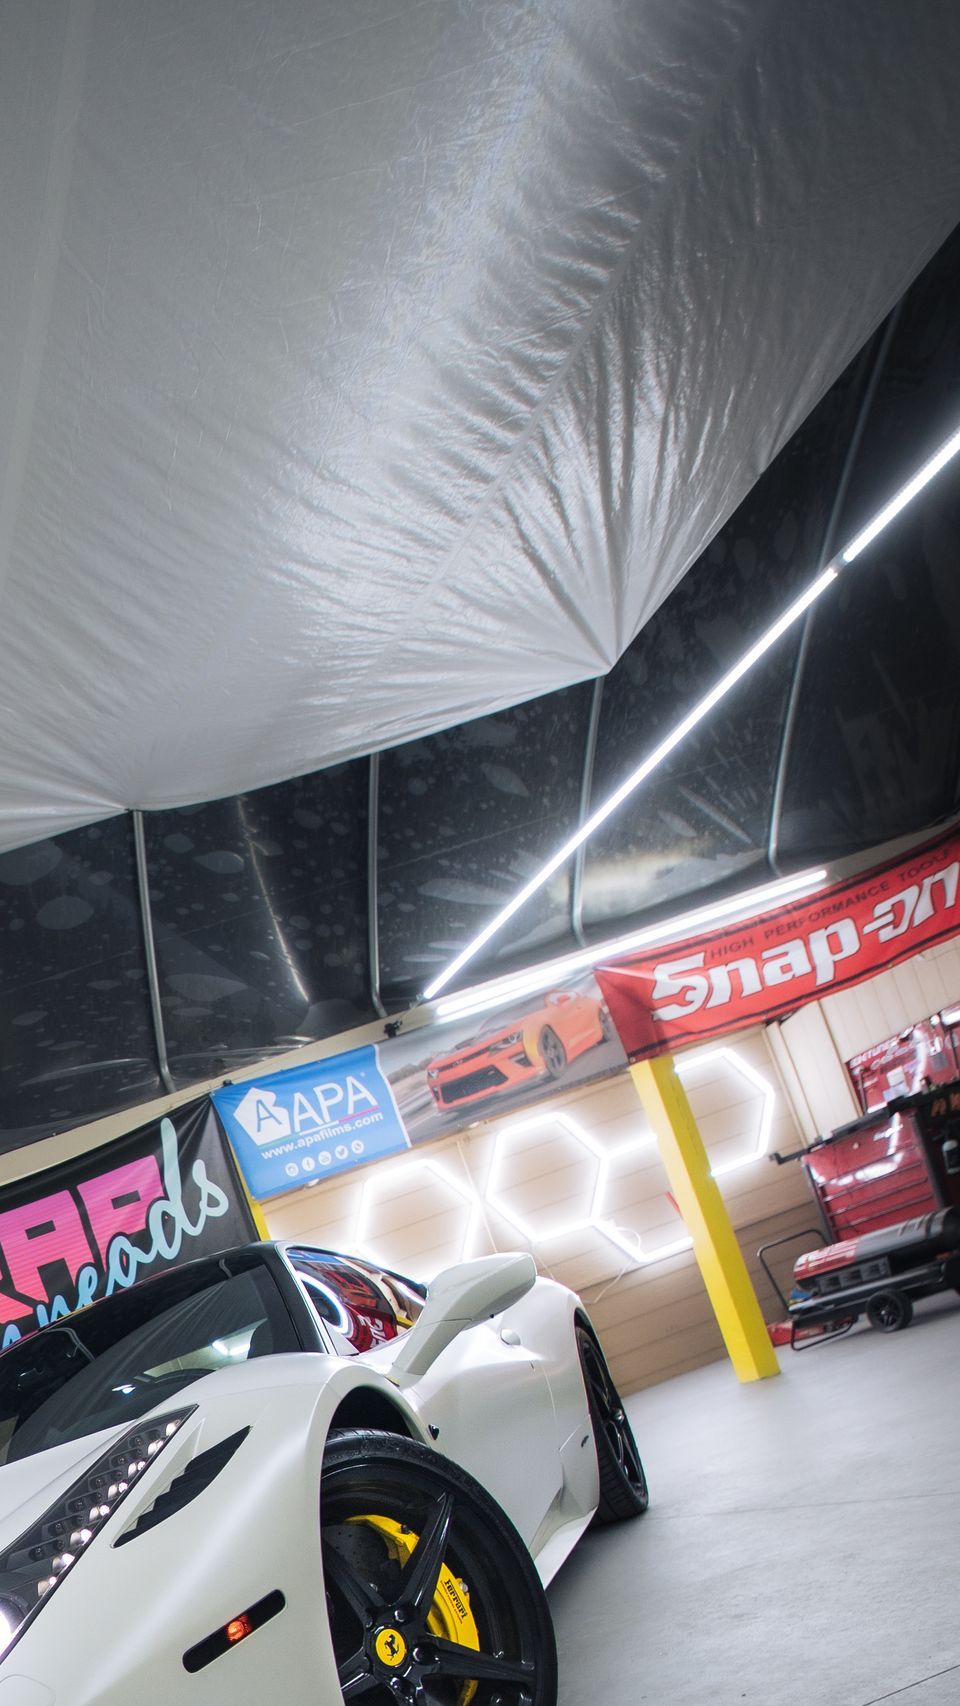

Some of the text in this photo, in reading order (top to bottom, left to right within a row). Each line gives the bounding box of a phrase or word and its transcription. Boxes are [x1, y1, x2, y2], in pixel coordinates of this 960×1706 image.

[710, 936, 755, 959] HIGH
[764, 881, 890, 940] PERFORMANCE
[261, 1112, 384, 1160] www.apafilms.com
[444, 1579, 468, 1619] Ferrari
